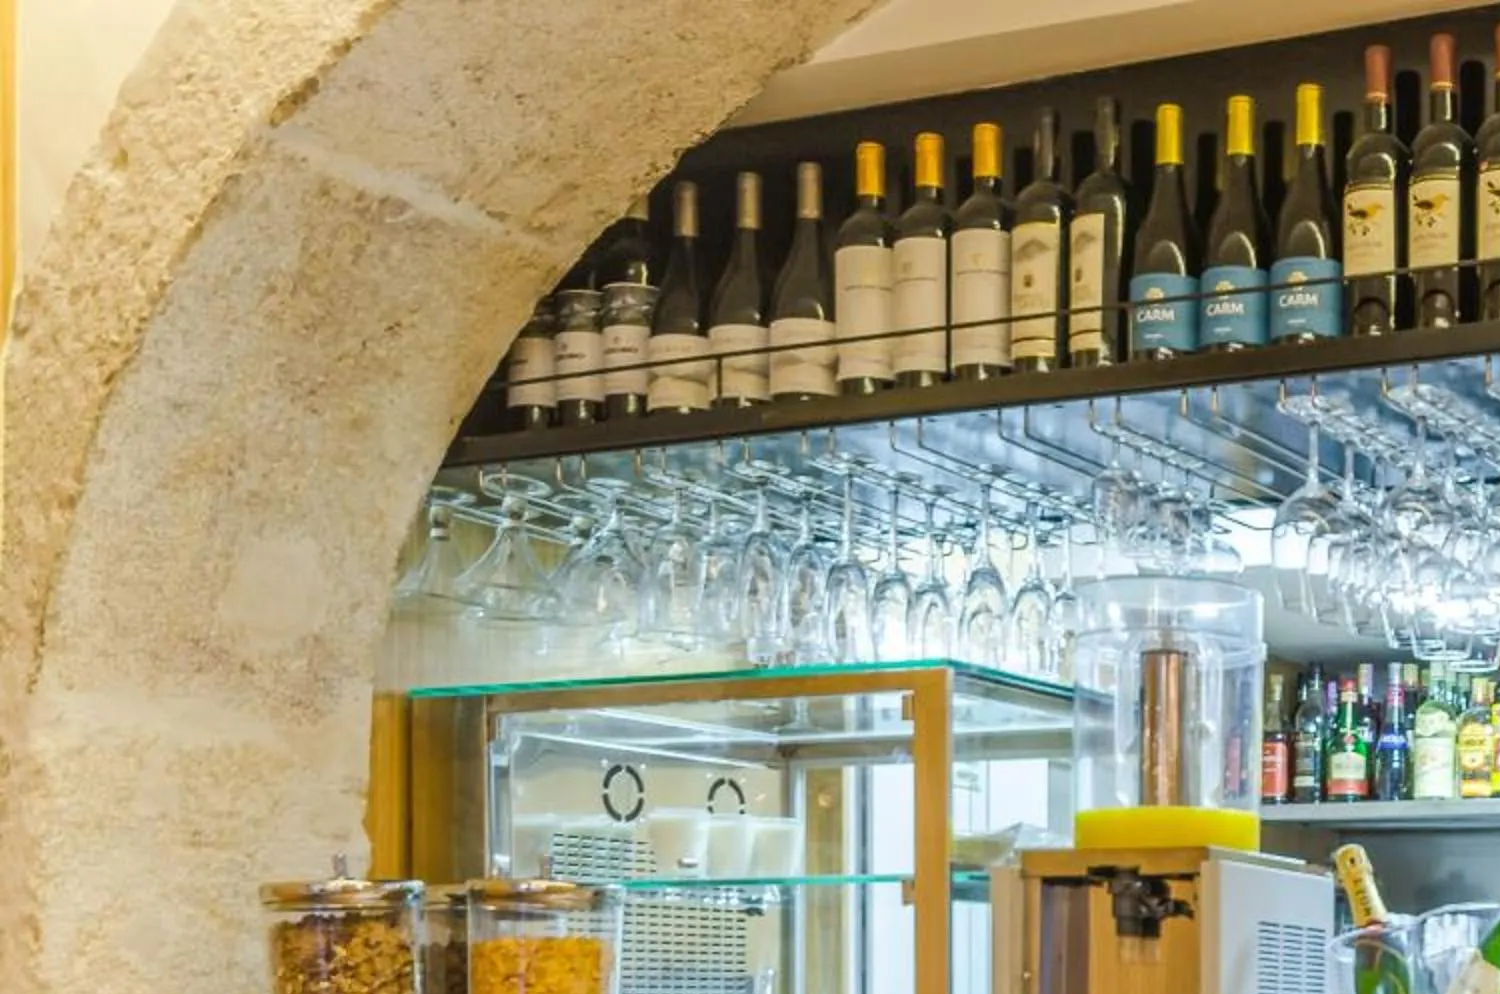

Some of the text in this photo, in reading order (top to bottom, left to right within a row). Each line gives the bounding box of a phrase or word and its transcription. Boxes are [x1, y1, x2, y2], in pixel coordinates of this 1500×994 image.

[1279, 292, 1319, 308] CARM
[1136, 307, 1176, 323] CARM
[1206, 302, 1245, 317] CARM
